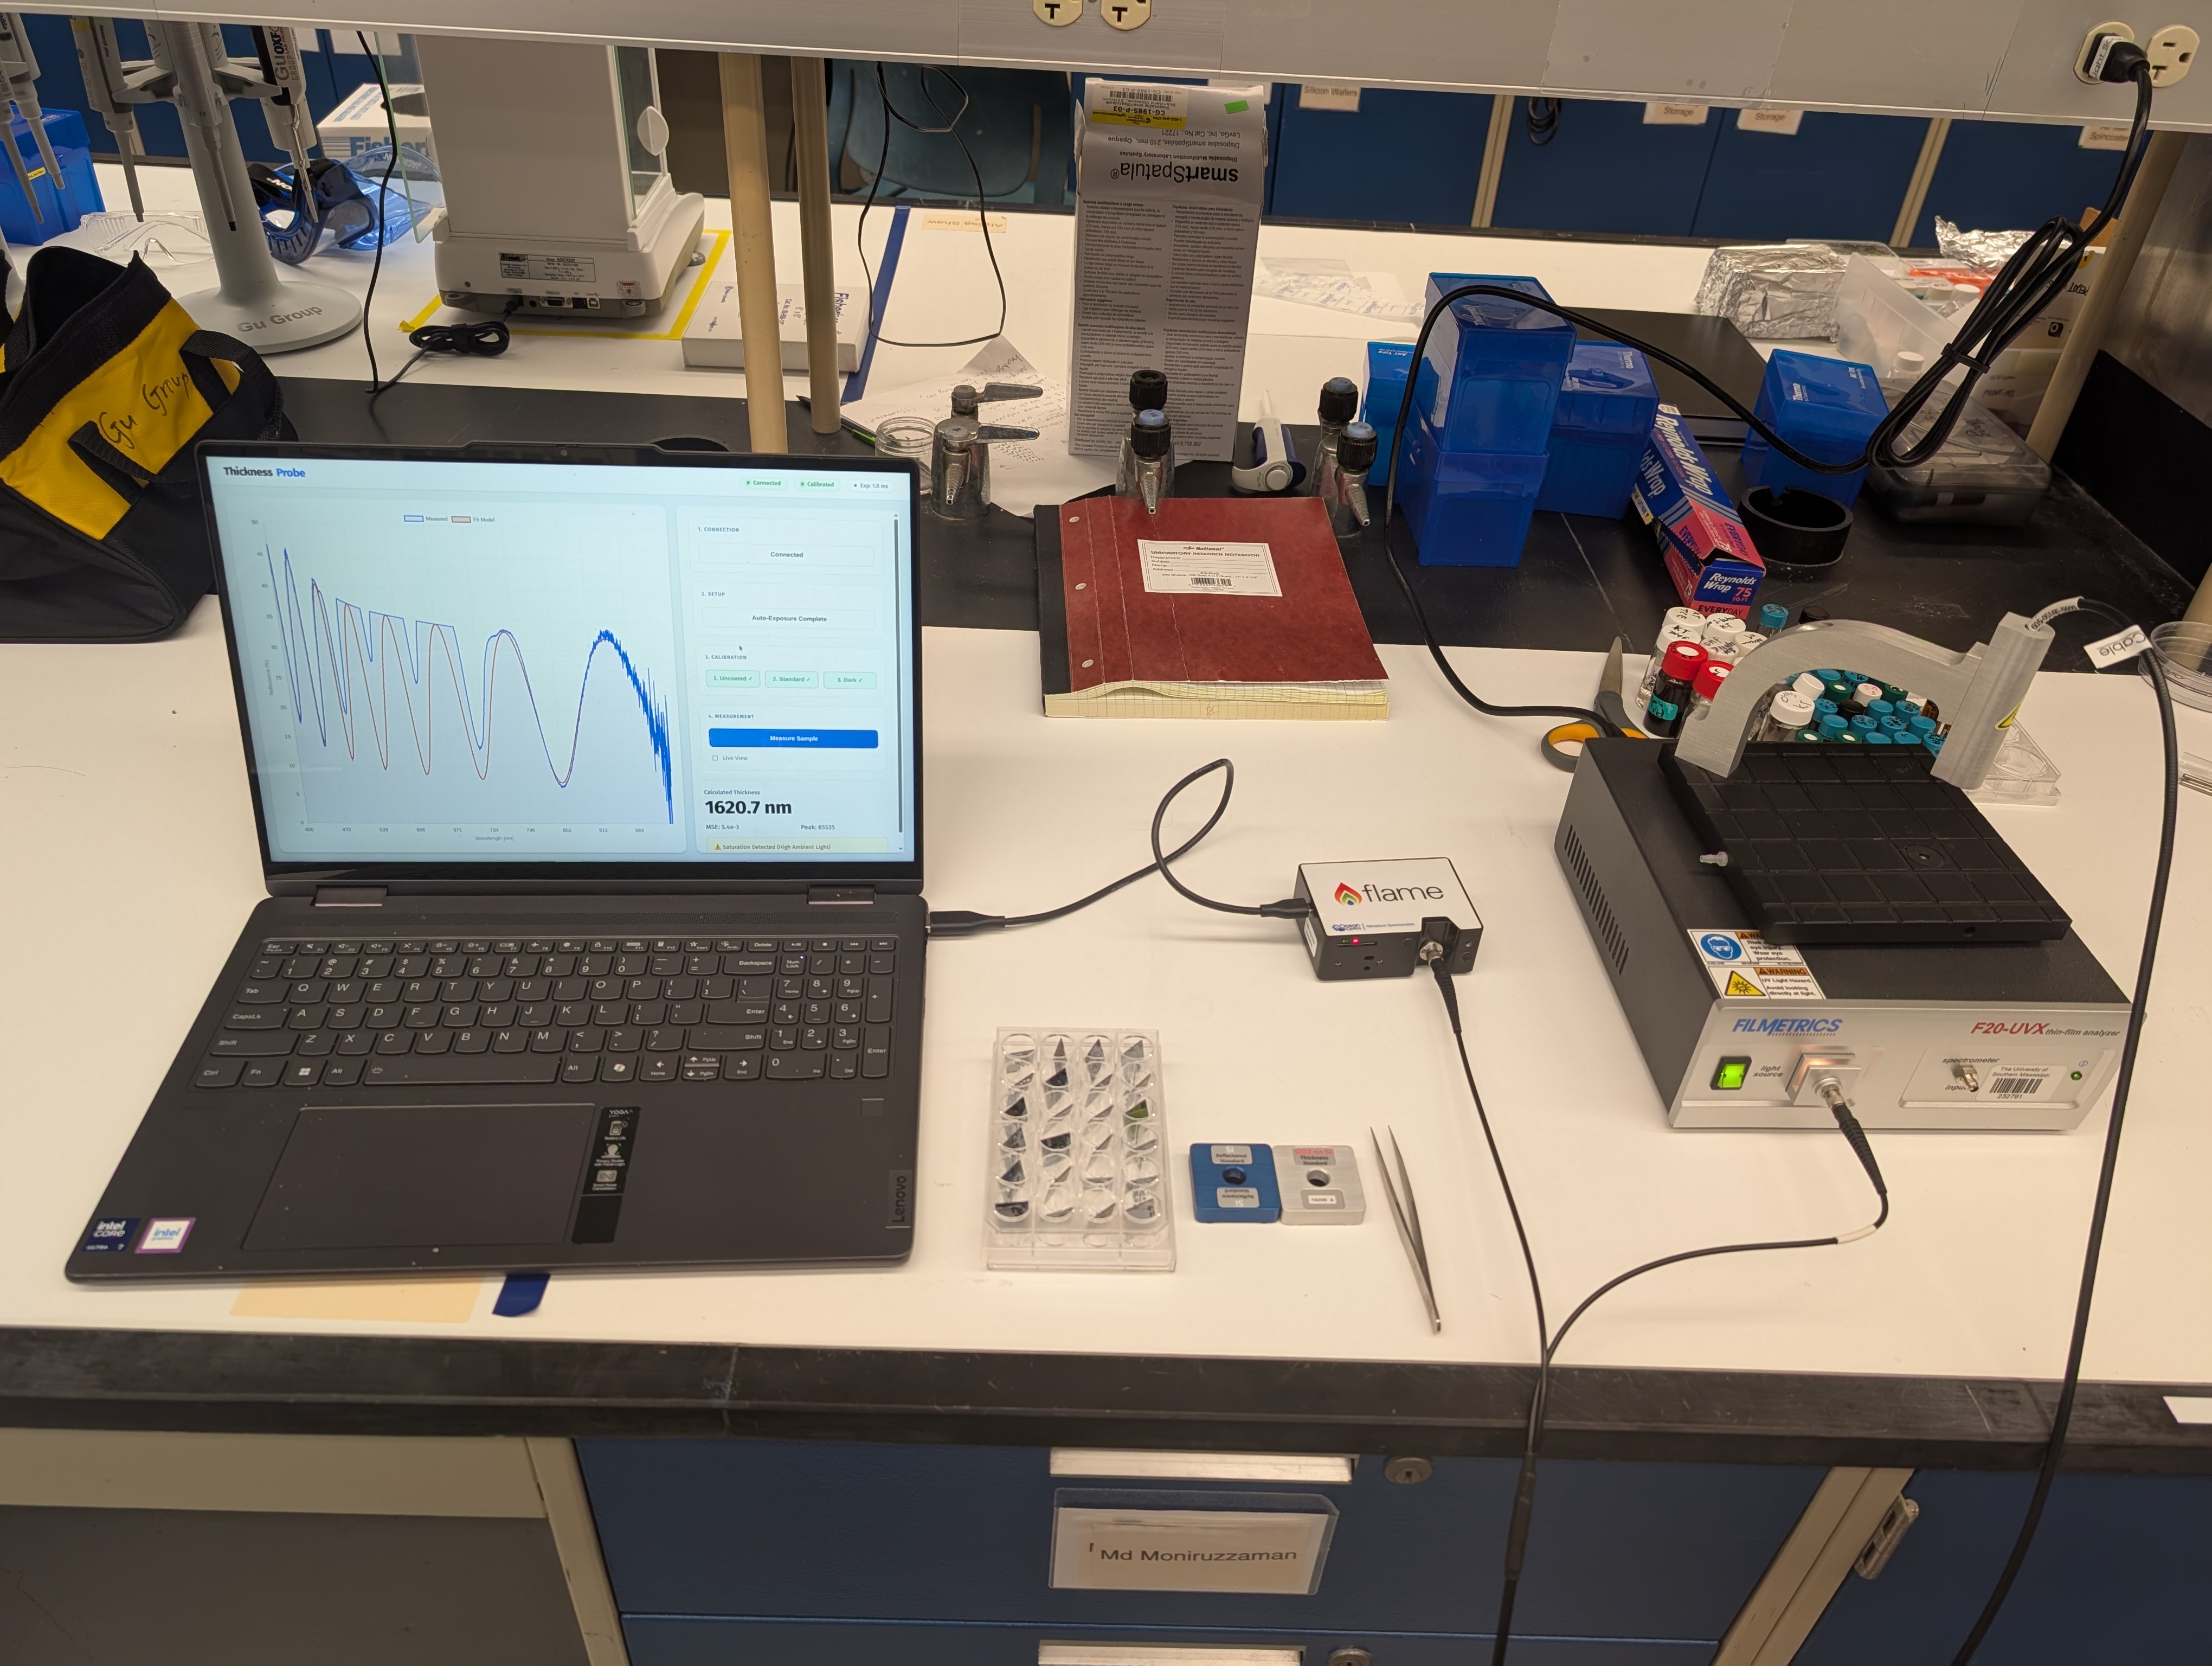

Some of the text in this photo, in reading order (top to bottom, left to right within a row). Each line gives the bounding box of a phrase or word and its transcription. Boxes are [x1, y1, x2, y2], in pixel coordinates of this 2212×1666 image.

[287, 55, 298, 80] GROUP
[1304, 85, 1358, 98] Silicon Wafers
[1113, 106, 1165, 116] CG-1985-P-03
[1663, 106, 1694, 118] Storage
[1755, 111, 1786, 123] Storage
[237, 304, 324, 335] Gu Group
[1792, 383, 1803, 401] Thermo
[98, 371, 191, 450] Gu Group
[1654, 413, 1699, 464] Reynolds
[1682, 459, 1714, 496] Wrap
[223, 466, 306, 478] Thickness Probe
[1724, 522, 1751, 559] EVERYDAY
[1709, 573, 1757, 585] Reynolds
[1703, 581, 1752, 598] Wrap 75
[1697, 605, 1744, 616] EVERYDAY
[2097, 631, 2146, 658] Cable
[705, 800, 792, 814] 1620.7 nm
[1361, 884, 1444, 902] flame
[1732, 1018, 1843, 1036] FILMETRICS
[1970, 1022, 2050, 1035] F20-UVX
[1942, 1056, 2000, 1065] spectrometer
[891, 1175, 907, 1223] Lenovo
[97, 1220, 126, 1230] intel
[153, 1228, 182, 1238] intel
[1101, 1548, 1297, 1563] Md Moniruzzaman
